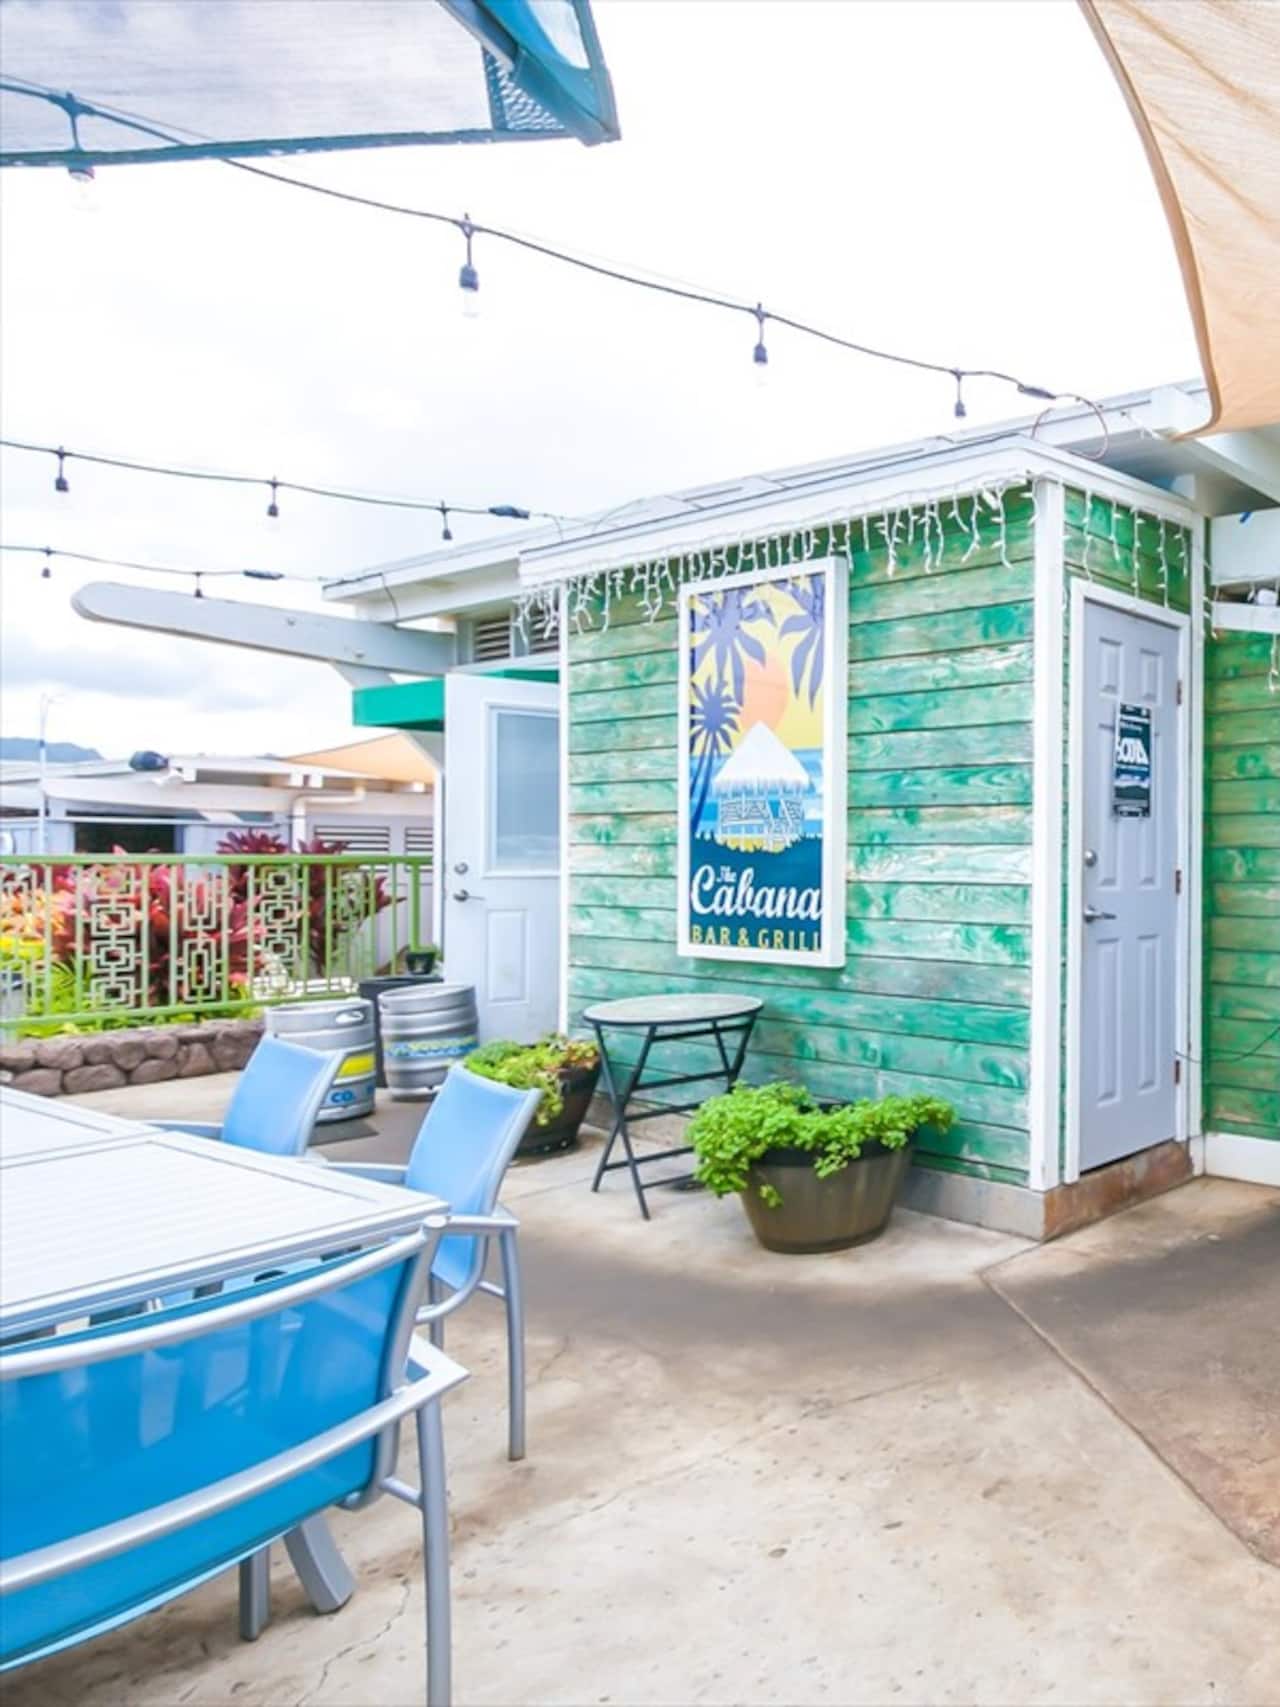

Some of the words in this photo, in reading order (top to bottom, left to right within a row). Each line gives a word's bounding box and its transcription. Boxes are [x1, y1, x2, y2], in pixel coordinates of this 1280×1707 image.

[715, 865, 737, 883] The
[691, 865, 824, 920] Cabana
[692, 924, 731, 946] BAR
[737, 926, 751, 948] &
